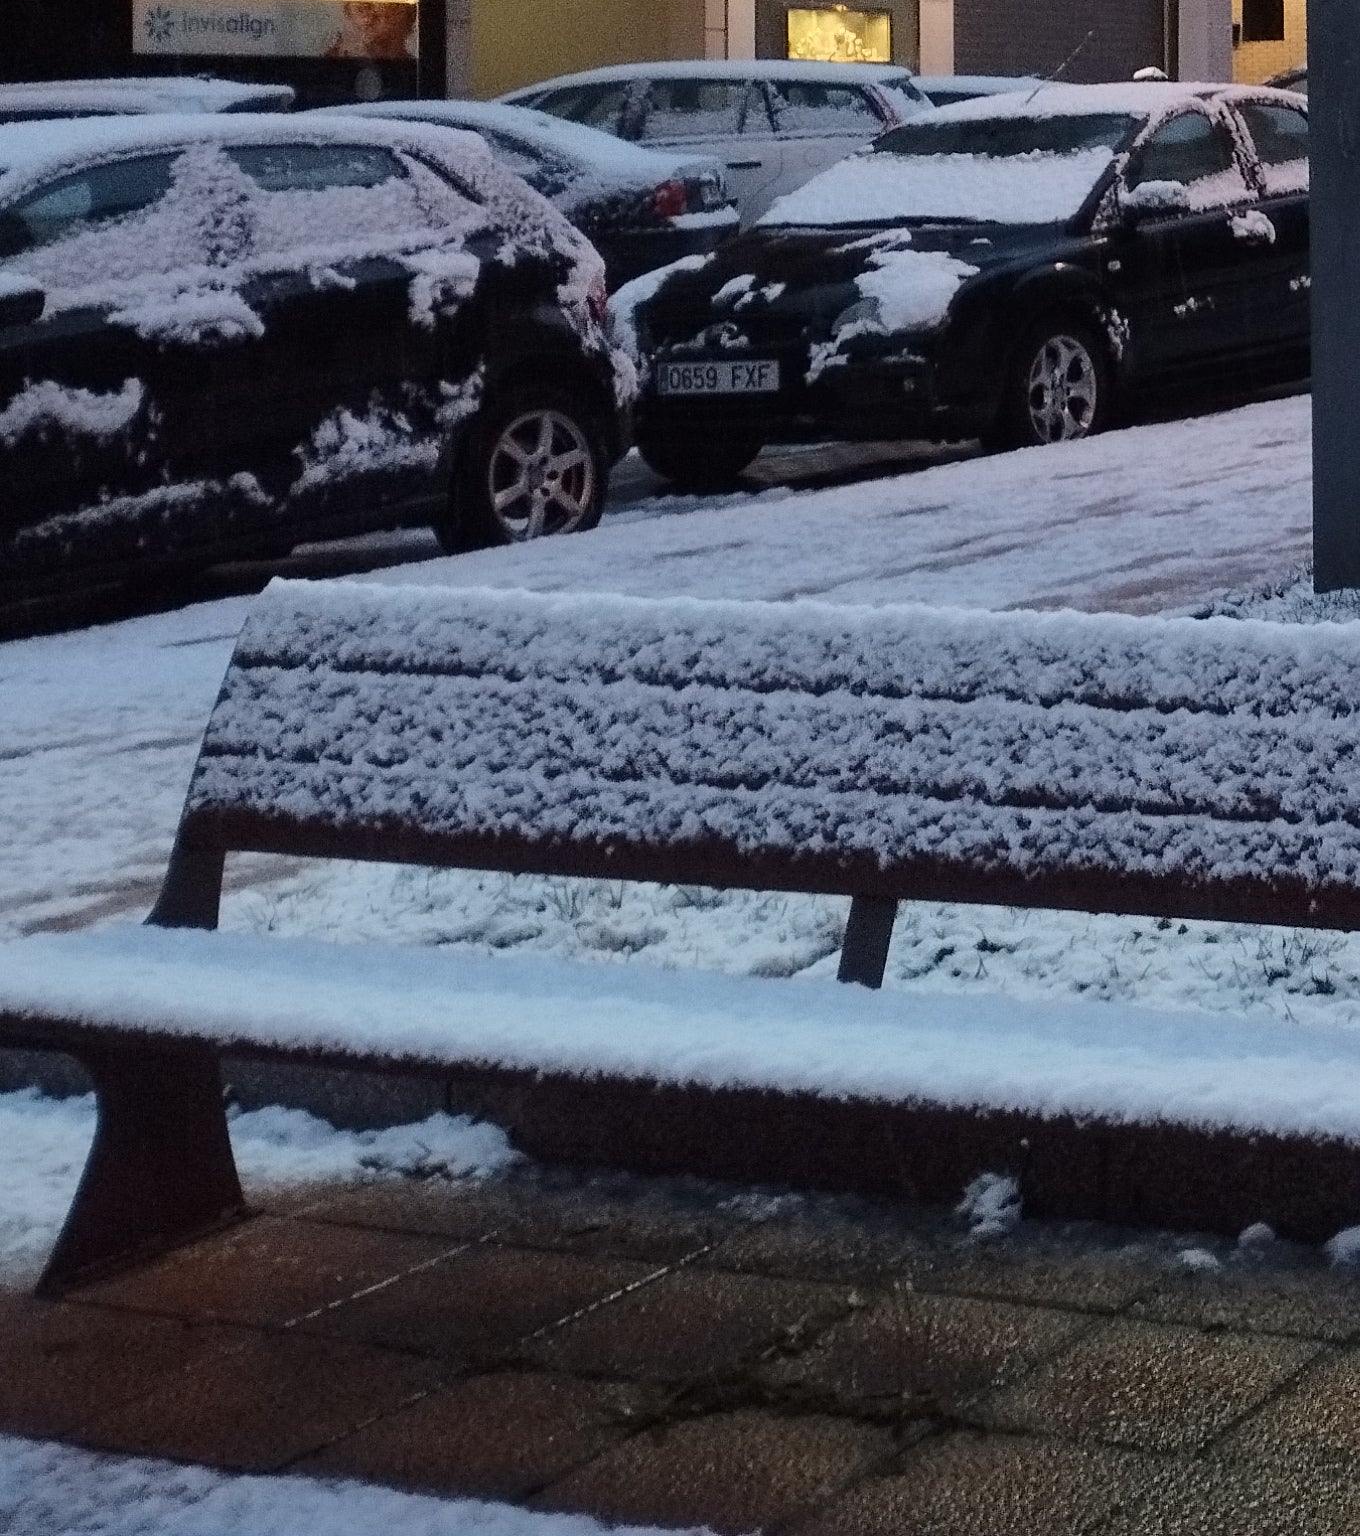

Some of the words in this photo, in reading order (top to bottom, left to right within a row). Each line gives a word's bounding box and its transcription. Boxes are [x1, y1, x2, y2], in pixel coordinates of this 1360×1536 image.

[182, 13, 276, 38] invisalign
[670, 366, 717, 389] 0659
[731, 364, 770, 388] FXF
